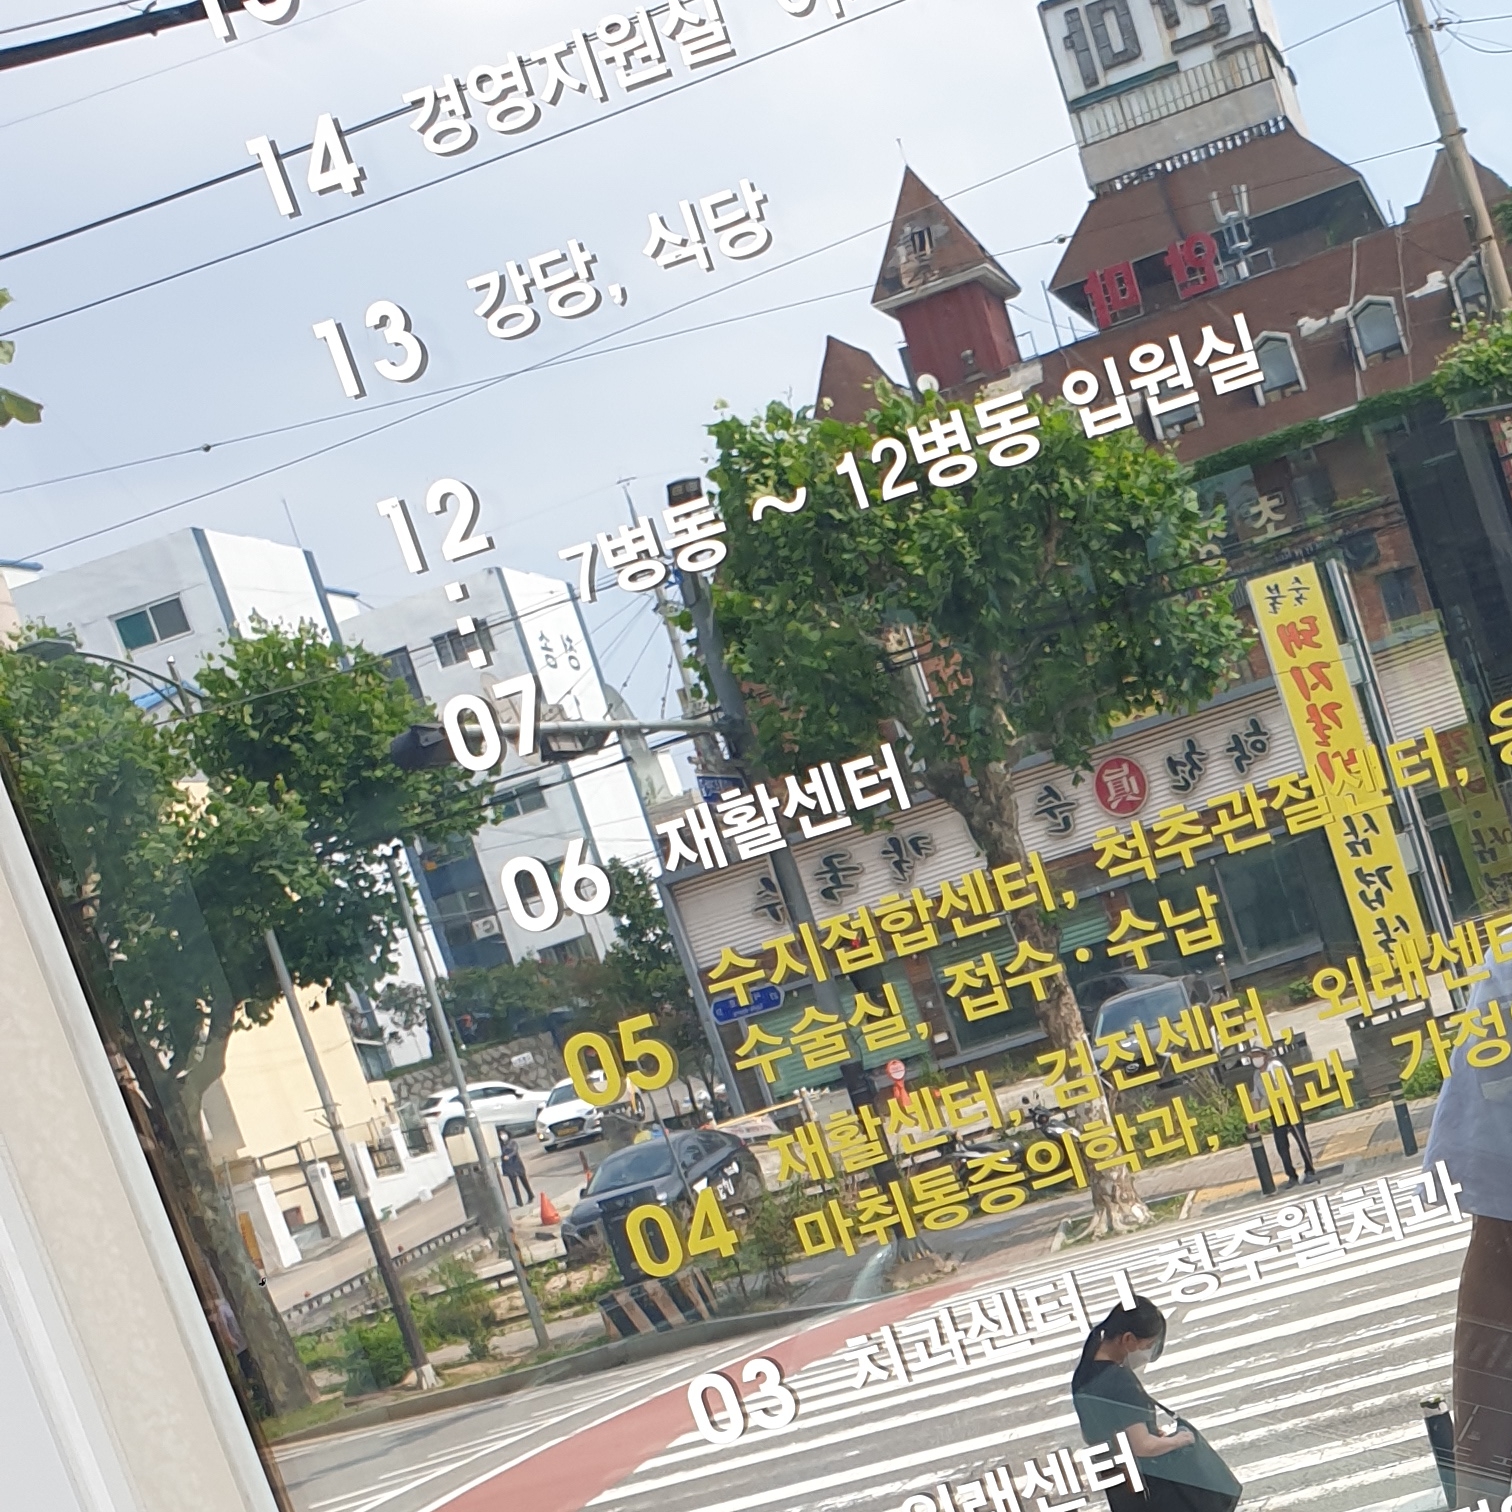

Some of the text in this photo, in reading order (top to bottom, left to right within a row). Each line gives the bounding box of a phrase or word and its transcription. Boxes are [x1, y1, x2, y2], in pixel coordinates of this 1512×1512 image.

[246, 0, 735, 216] 14 경영지원실
[312, 178, 771, 398] 13 강당, 식당
[376, 478, 492, 574] 12
[558, 495, 727, 604] 7병동
[835, 394, 1043, 511] 12병동
[1061, 312, 1264, 438] 입원실
[443, 675, 540, 770] 07
[500, 743, 911, 933] 06 재활센터
[708, 853, 1077, 1007] 수지접합센터,
[1092, 728, 1468, 880] 척추관절센터,
[564, 1012, 678, 1106] 05
[735, 983, 930, 1083] 수술실,
[769, 1072, 1023, 1183] 재활센터,
[1037, 989, 1291, 1106] 검진센터,
[626, 1187, 740, 1277] 04
[795, 1098, 1220, 1258] 마취통증의학과,
[1237, 1050, 1355, 1130] 내과
[688, 1358, 796, 1446] 03
[845, 1270, 1090, 1391] 치과센터
[1159, 1160, 1464, 1306] 청주웰치과
